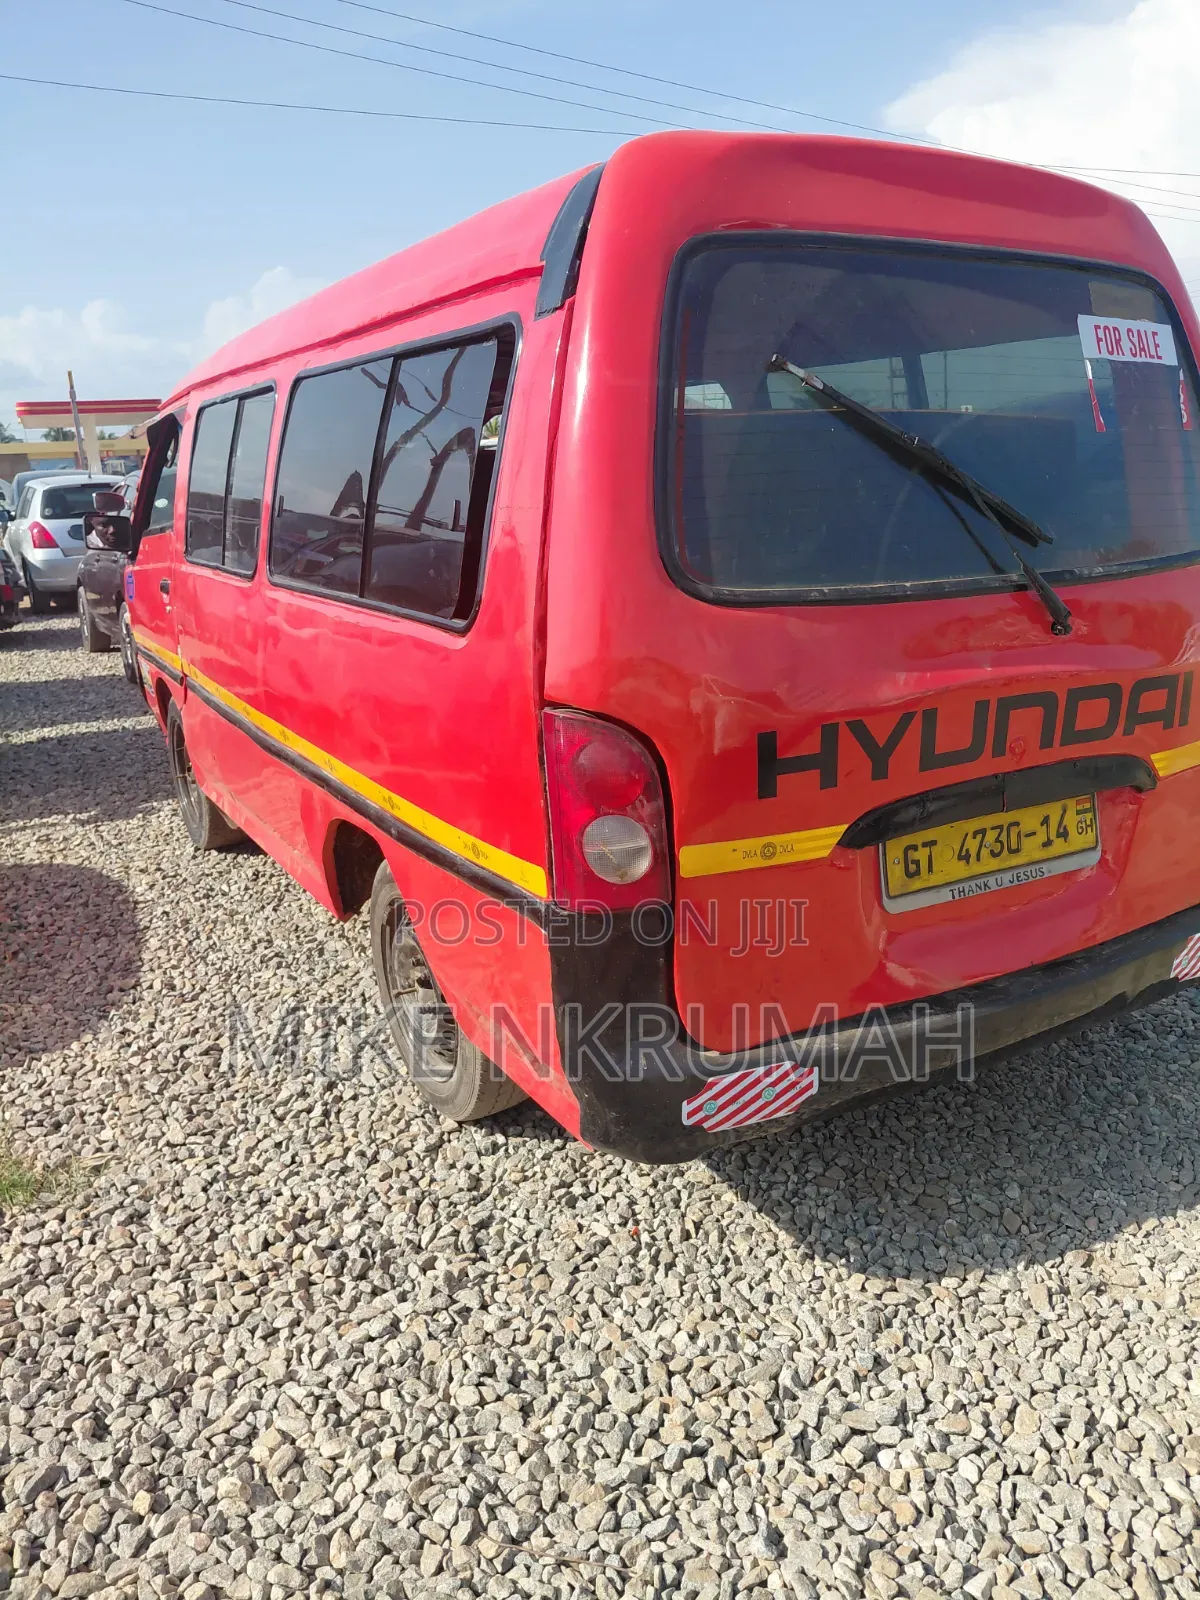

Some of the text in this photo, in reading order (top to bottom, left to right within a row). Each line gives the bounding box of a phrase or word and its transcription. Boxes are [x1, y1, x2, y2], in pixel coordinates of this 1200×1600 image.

[1093, 324, 1163, 361] FOR SALE
[757, 670, 1194, 800] HYUNDAI
[903, 803, 1070, 879] GT 4730-14
[1076, 818, 1094, 836] GH
[949, 866, 1046, 901] THANK U JESUS
